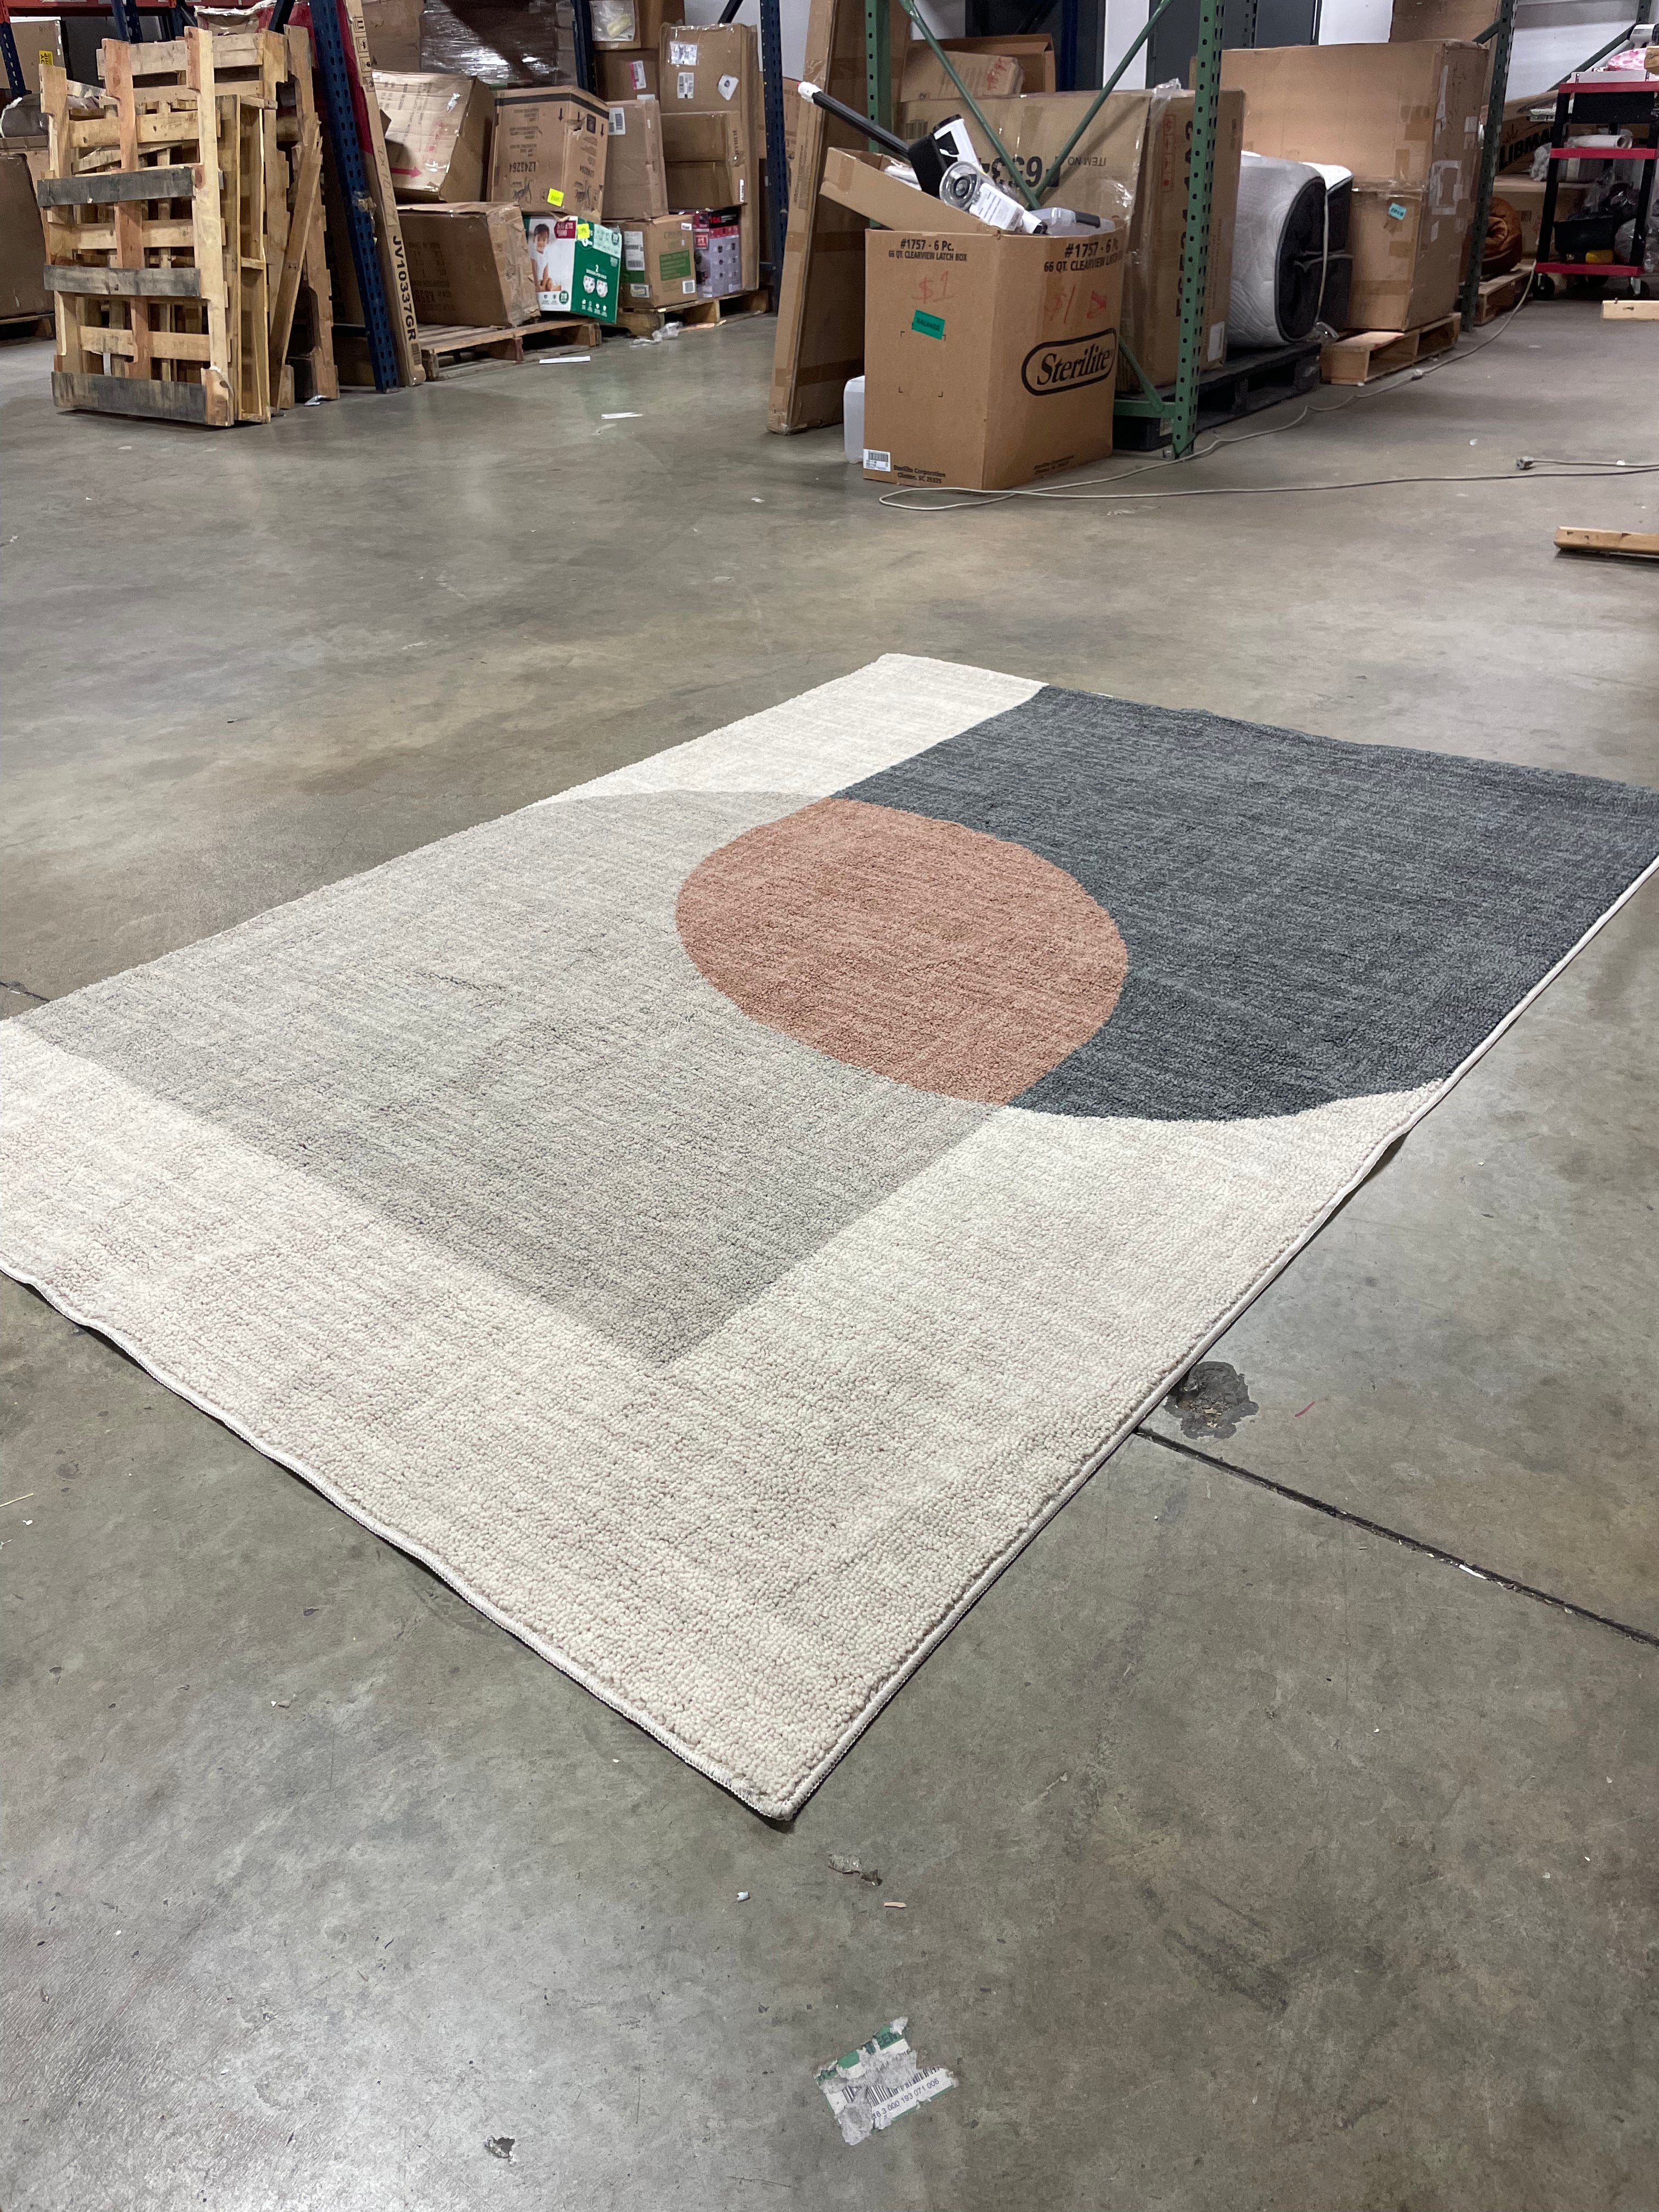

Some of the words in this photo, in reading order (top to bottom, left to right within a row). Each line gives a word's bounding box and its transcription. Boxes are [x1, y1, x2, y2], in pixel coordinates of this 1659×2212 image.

[900, 238, 926, 250] #1757
[934, 240, 939, 251] 6
[942, 240, 954, 252] Pc.
[1064, 242, 1098, 258] #1757
[1105, 239, 1111, 253] 6
[905, 251, 935, 260] CLEARVIEW
[936, 252, 953, 261] LATCH
[1044, 261, 1054, 273] 66
[1056, 261, 1068, 273] QT.
[392, 235, 416, 341] JV10337GR
[1036, 343, 1110, 386] Sterilite
[887, 2100, 900, 2111] 000
[901, 2093, 913, 2103] 193
[913, 2085, 926, 2096] 071
[927, 2078, 939, 2089] 006
